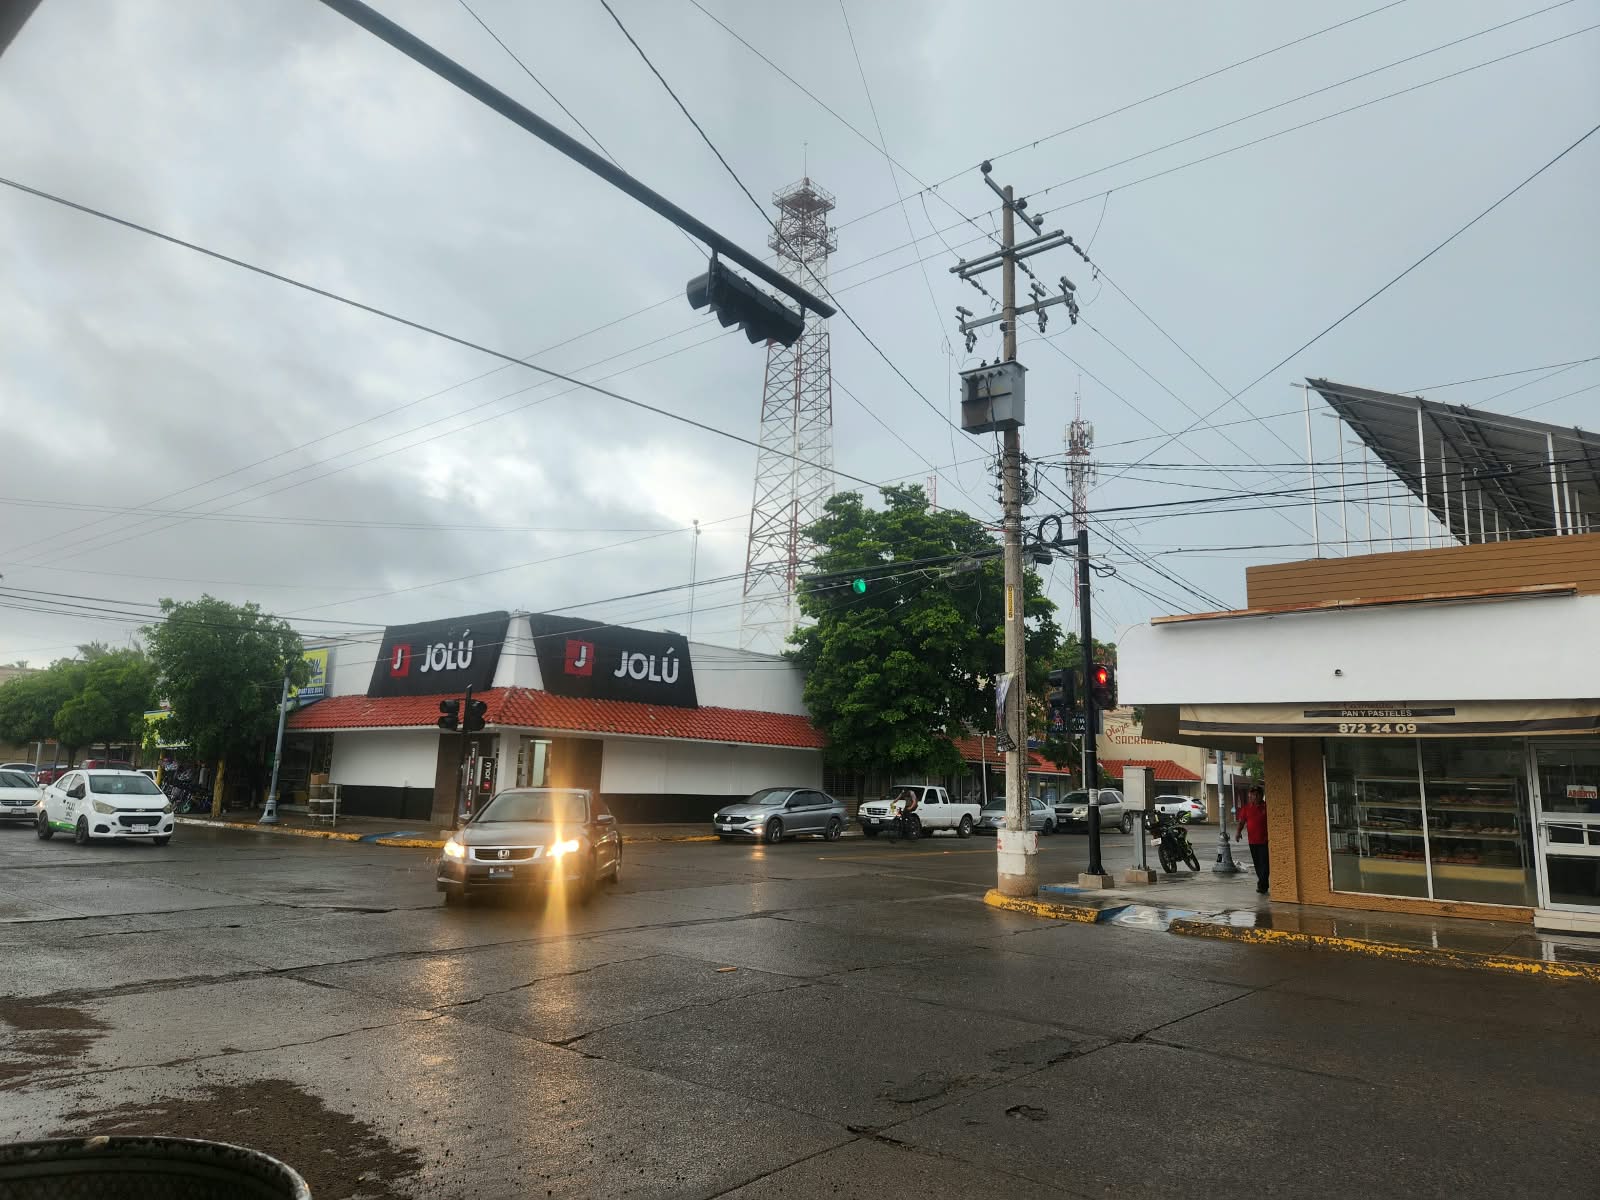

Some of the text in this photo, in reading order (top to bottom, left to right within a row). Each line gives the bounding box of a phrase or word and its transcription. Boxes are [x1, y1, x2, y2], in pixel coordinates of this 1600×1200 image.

[393, 629, 474, 673] J JOLÚ
[574, 645, 680, 684] J JOLÚ
[1368, 709, 1412, 717] PASTELES
[1339, 723, 1417, 734] 872 24 09
